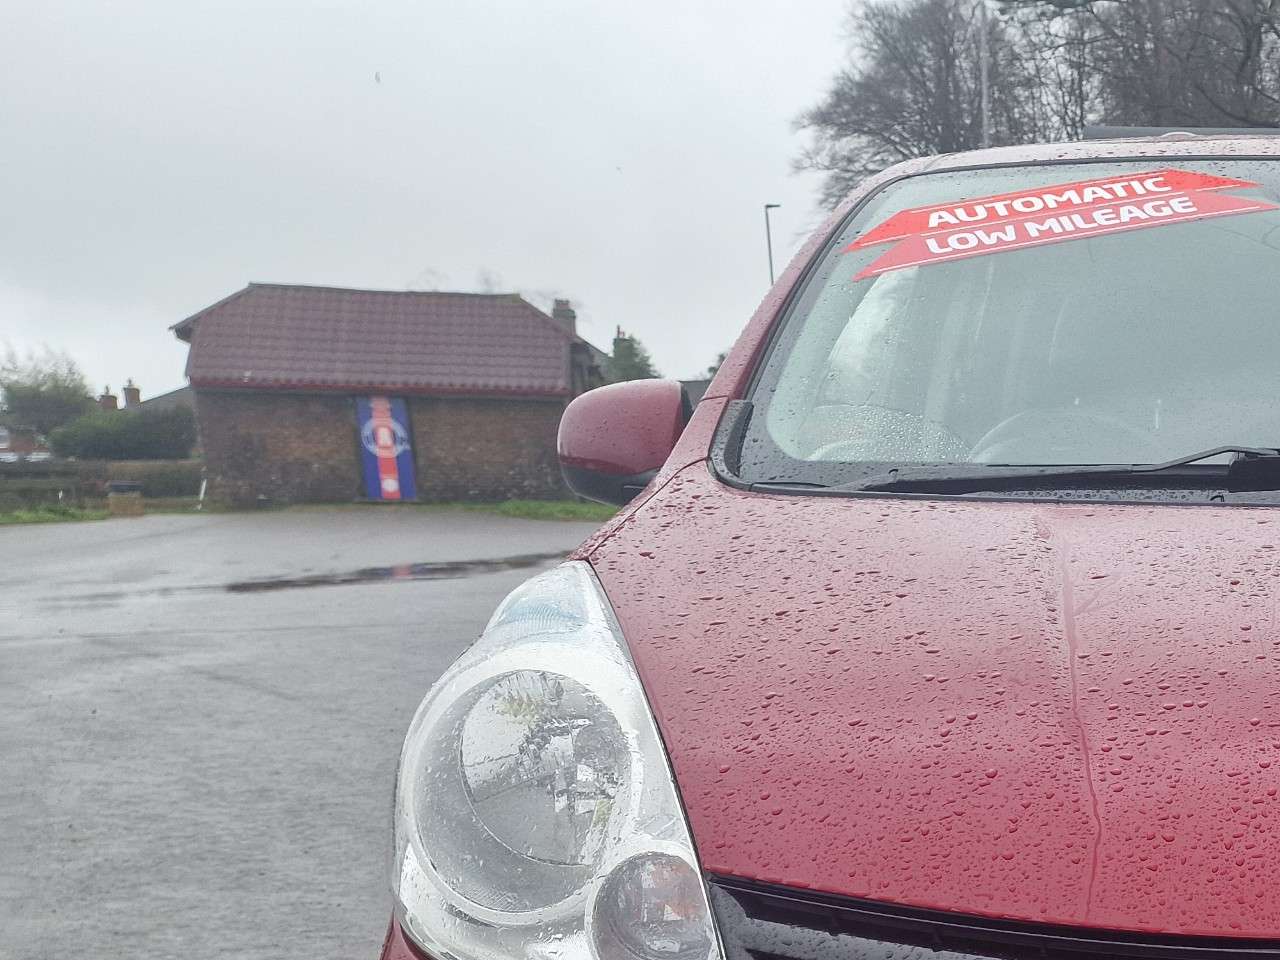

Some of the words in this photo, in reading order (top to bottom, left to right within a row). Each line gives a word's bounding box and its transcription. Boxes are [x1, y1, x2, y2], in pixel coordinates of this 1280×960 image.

[926, 224, 1018, 255] LOW
[1024, 197, 1198, 239] MILEAGE
[928, 176, 1172, 228] AUTOMATIC
